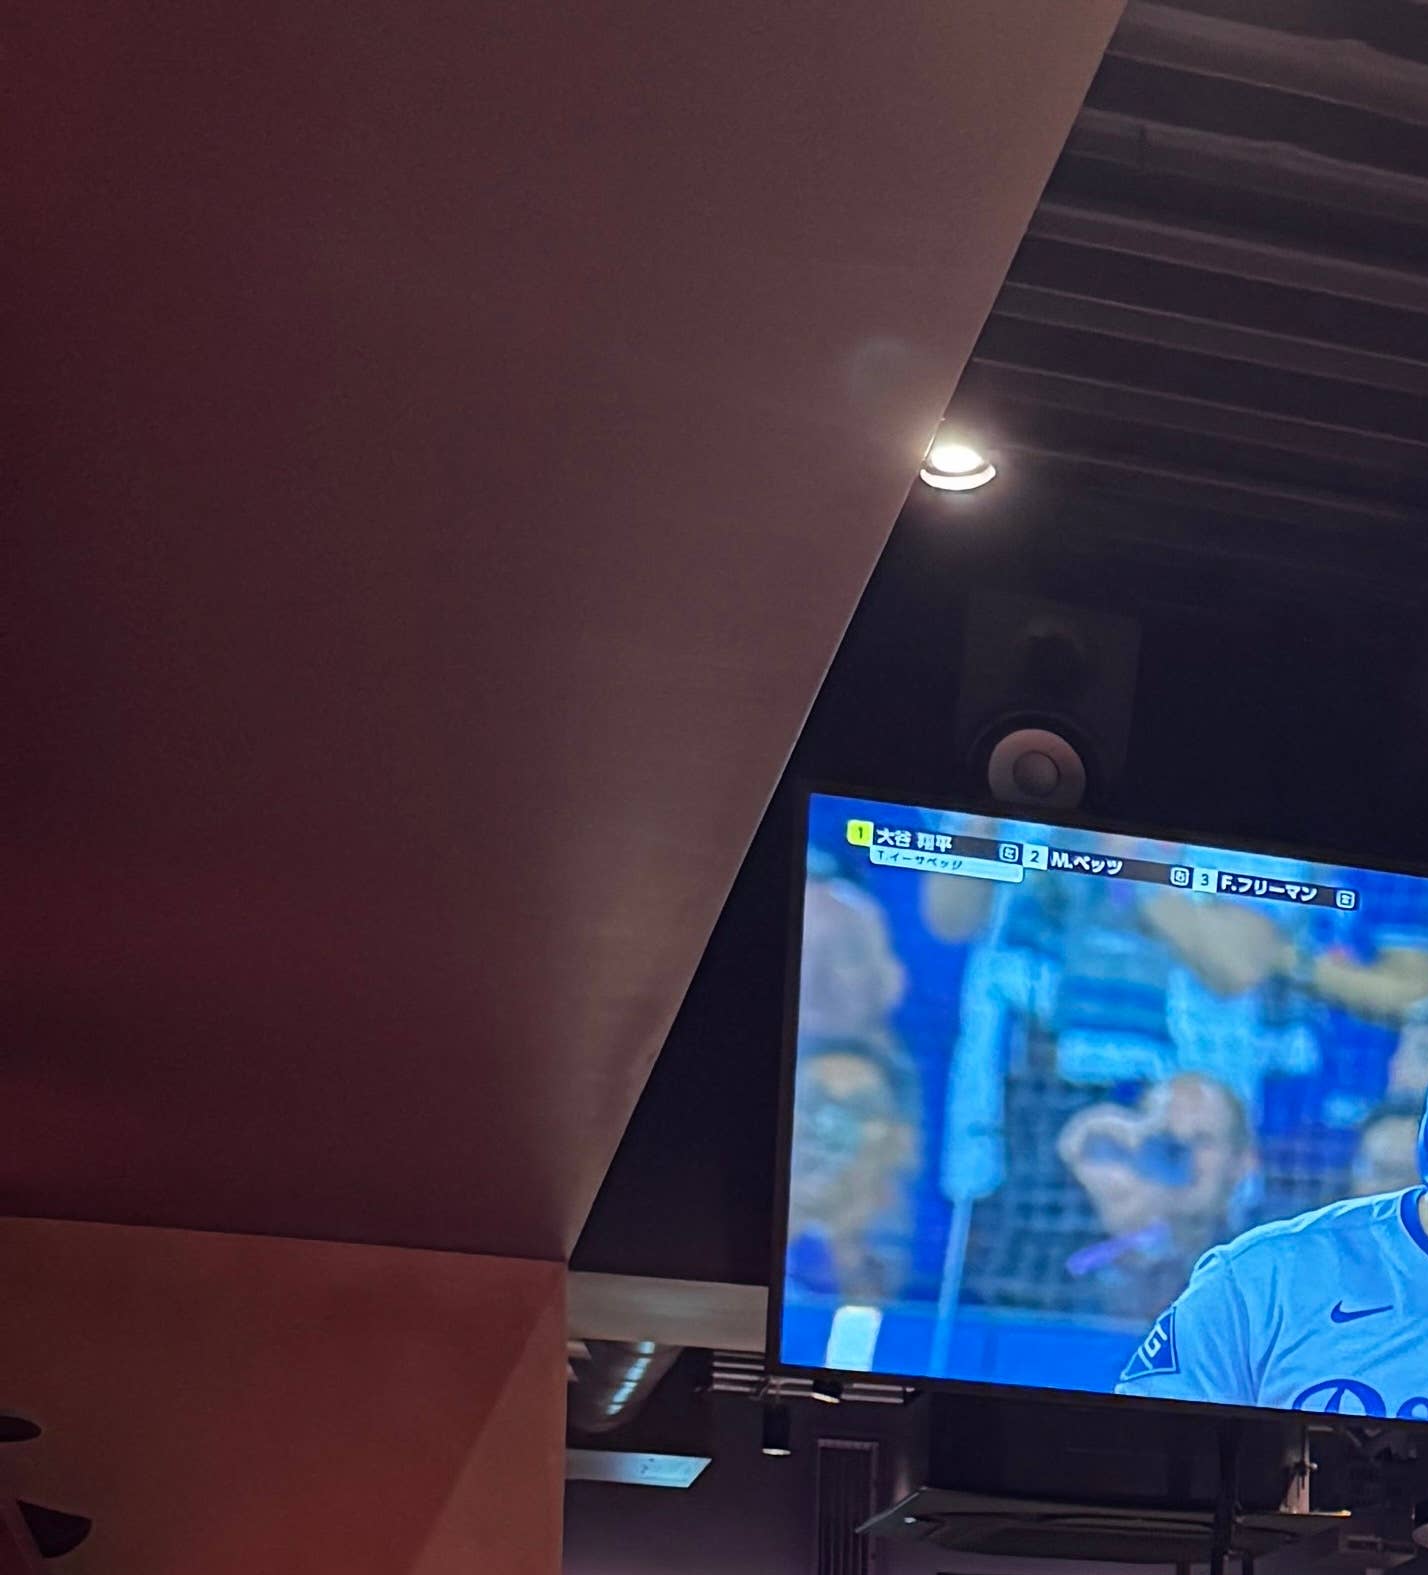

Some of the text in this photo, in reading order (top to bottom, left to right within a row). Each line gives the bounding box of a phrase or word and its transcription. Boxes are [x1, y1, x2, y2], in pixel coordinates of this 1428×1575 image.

[876, 827, 912, 848] 大谷
[1200, 873, 1209, 887] 3
[1220, 875, 1318, 902] F.フリーマン
